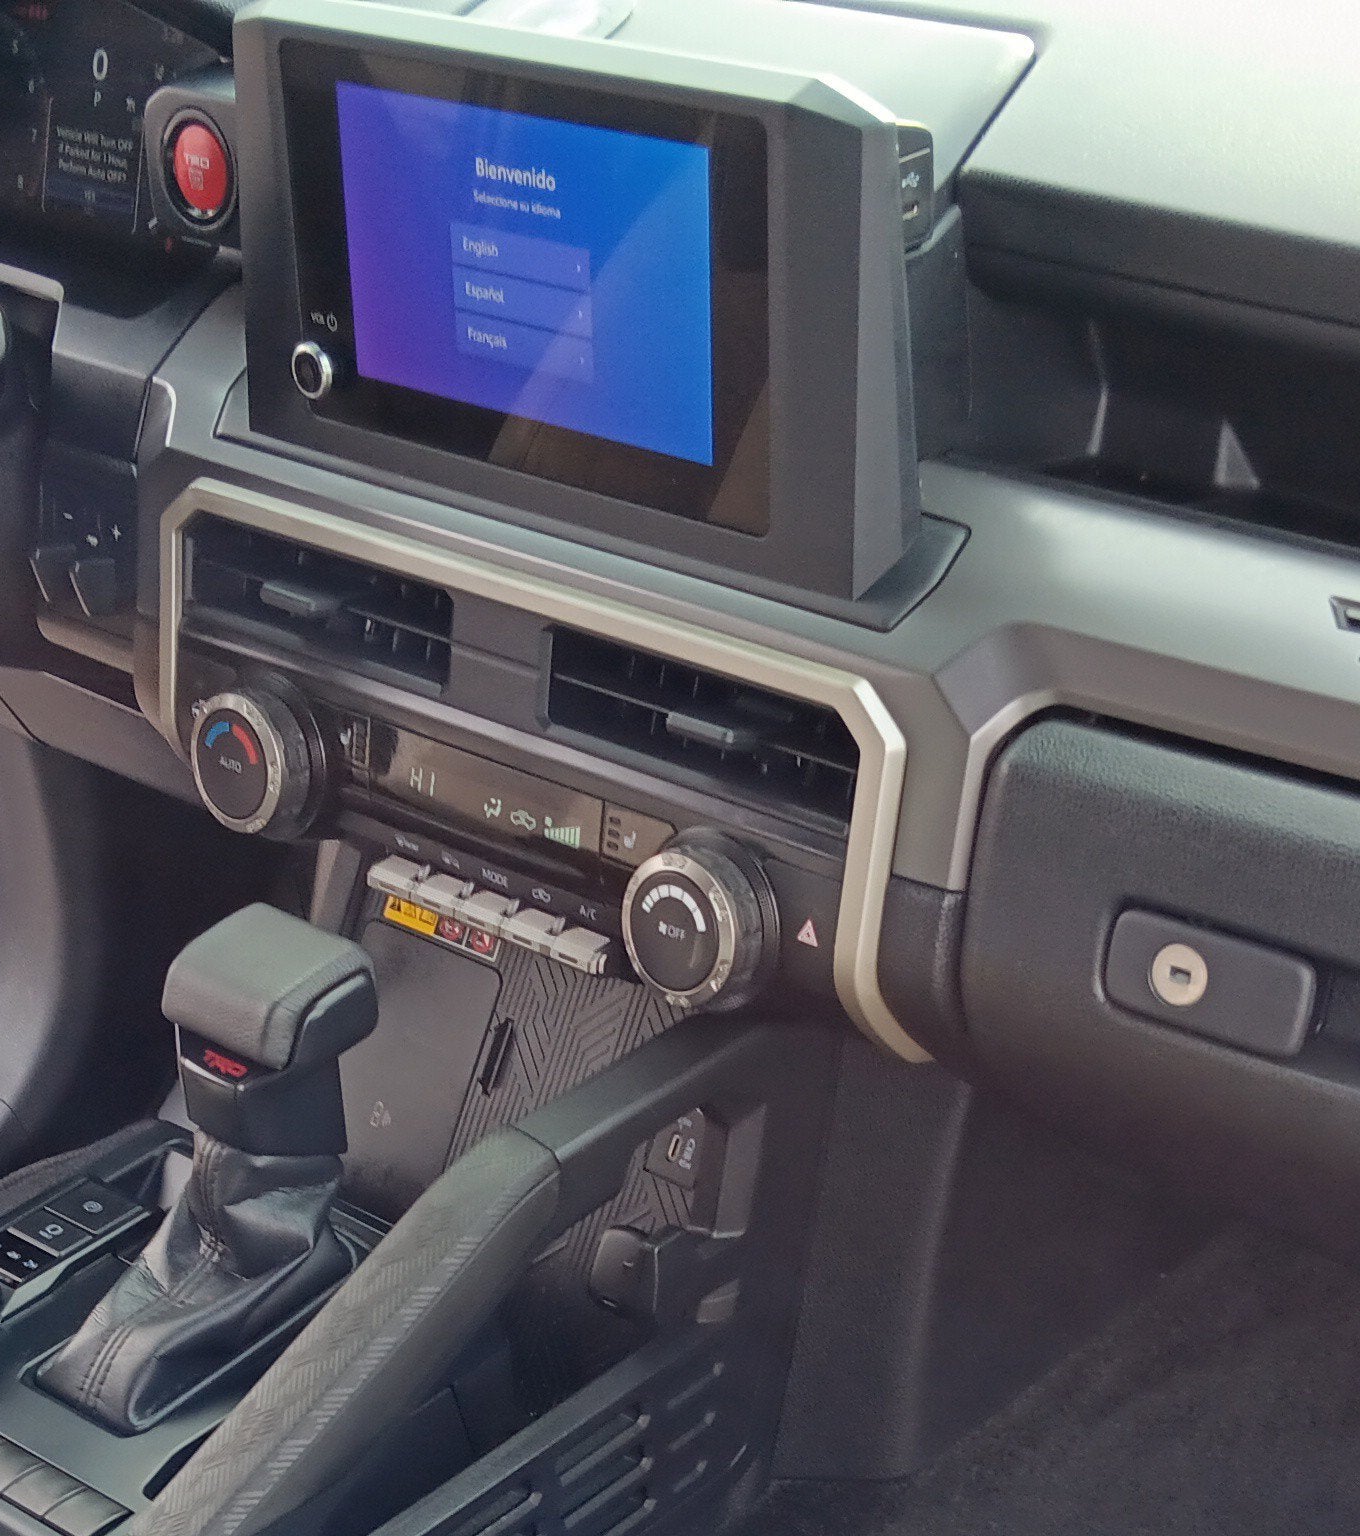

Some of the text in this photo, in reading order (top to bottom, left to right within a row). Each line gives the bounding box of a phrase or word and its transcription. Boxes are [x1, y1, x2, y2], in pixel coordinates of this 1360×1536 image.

[92, 47, 109, 81] 0
[474, 155, 557, 192] Bienvenido
[472, 187, 562, 220] Seleccione su idioma
[462, 235, 500, 258] English
[465, 281, 505, 305] Español
[467, 325, 508, 350] Français
[481, 867, 510, 889] MODE
[578, 903, 598, 922] A/C
[667, 924, 687, 941] OFF
